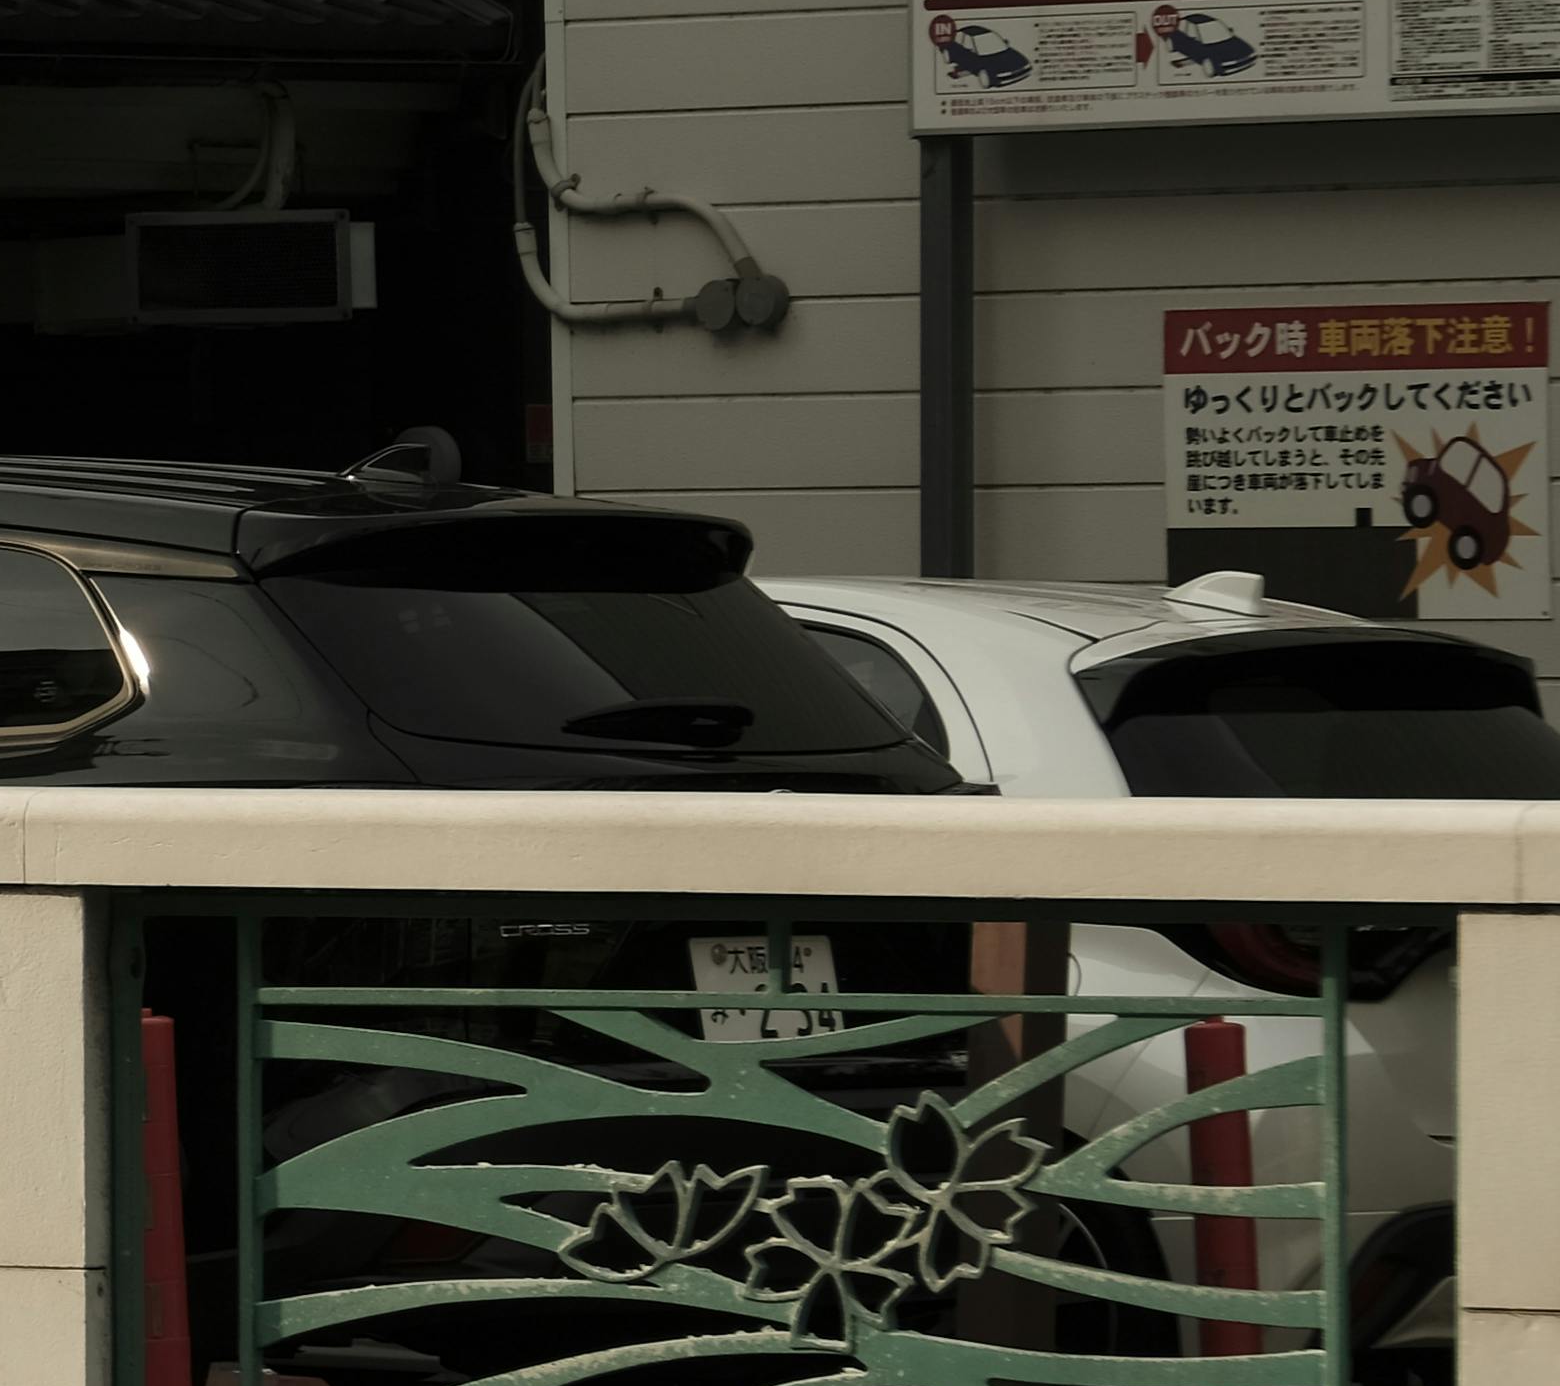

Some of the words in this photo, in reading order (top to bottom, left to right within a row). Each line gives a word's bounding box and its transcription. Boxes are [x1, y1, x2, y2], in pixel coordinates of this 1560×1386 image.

[935, 23, 952, 36] IN
[1154, 14, 1177, 27] OUT
[1180, 320, 1308, 359] バック時
[1184, 381, 1532, 415] ゆっくりとバックしてください
[727, 946, 768, 974] 大阪
